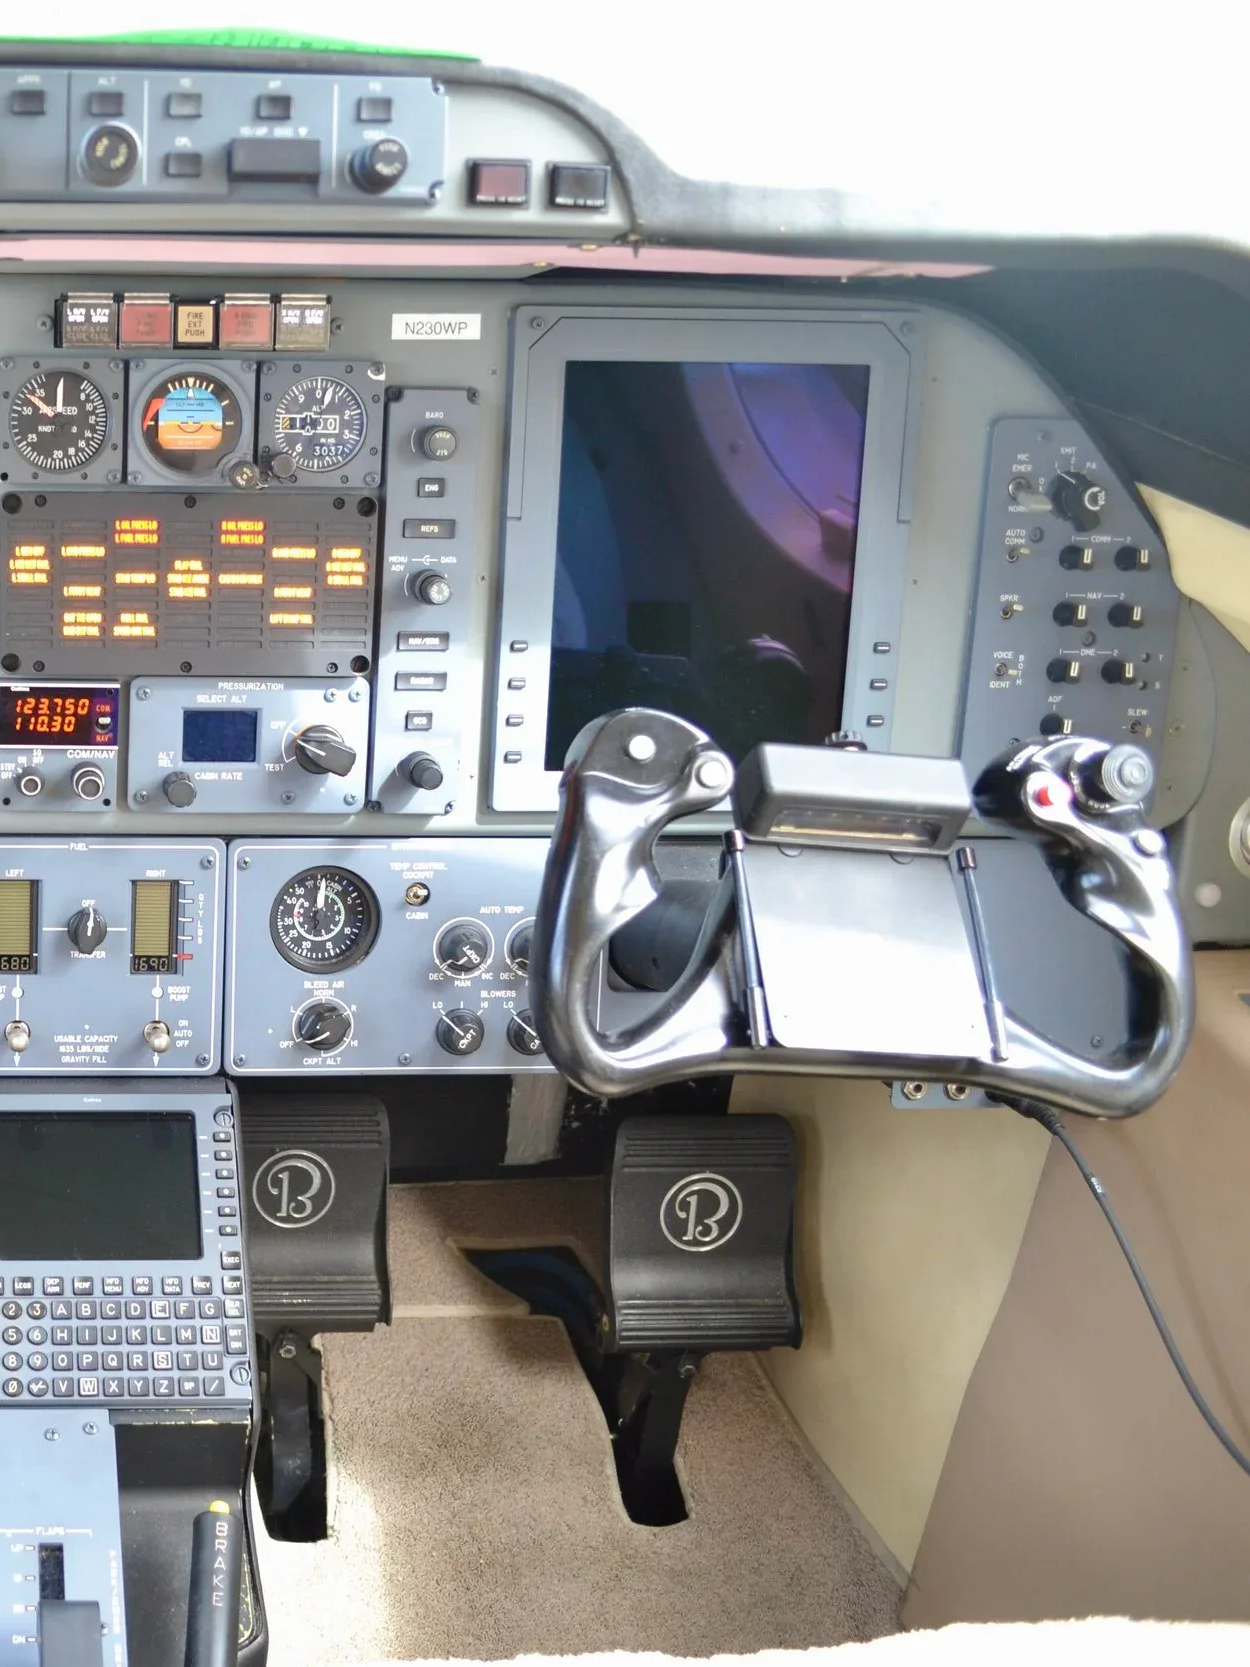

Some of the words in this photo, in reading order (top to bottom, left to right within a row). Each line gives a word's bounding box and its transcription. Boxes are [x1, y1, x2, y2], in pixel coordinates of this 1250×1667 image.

[186, 312, 204, 321] FIRE
[188, 320, 203, 329] EXT
[404, 321, 468, 336] N230WP
[184, 328, 205, 337] PUSH
[425, 411, 444, 419] BARO
[1012, 464, 1032, 472] EMER
[420, 525, 439, 533] REFS
[1005, 529, 1026, 537] AUTO
[1005, 537, 1025, 546] COMM
[388, 556, 408, 564] MENU
[440, 556, 457, 564] DATA
[999, 594, 1019, 602] SPKR
[1086, 592, 1102, 600] NAV
[217, 682, 285, 691] PRESSURIZATION
[989, 681, 1010, 689] IDENT
[196, 695, 225, 704] SELECT
[230, 695, 247, 704] ALT
[13, 698, 89, 715] 123.750
[95, 704, 111, 713] COM
[1127, 708, 1148, 716] SLEW
[14, 715, 75, 732] 110.30
[66, 749, 116, 760] COM/NAV
[157, 751, 175, 760] ALT
[264, 763, 285, 772] TEST
[194, 772, 219, 781] CABIN
[221, 772, 243, 781] RATE
[70, 843, 88, 851] FUEL
[5, 869, 24, 877] LEFT
[479, 906, 502, 915] AUTO
[504, 906, 525, 915] TEMP
[405, 912, 429, 920] CABIN
[428, 972, 444, 981] DEC
[480, 990, 517, 999] BLOWERS
[54, 1035, 82, 1043] USABLE
[84, 1035, 118, 1043] CAPACITY
[279, 1040, 295, 1049] OFF
[61, 1055, 90, 1064] GRAVITY
[92, 1055, 107, 1064] FILL
[303, 1057, 323, 1066] CKPT
[326, 1057, 341, 1066] ALT
[213, 1521, 228, 1607] BRAKE
